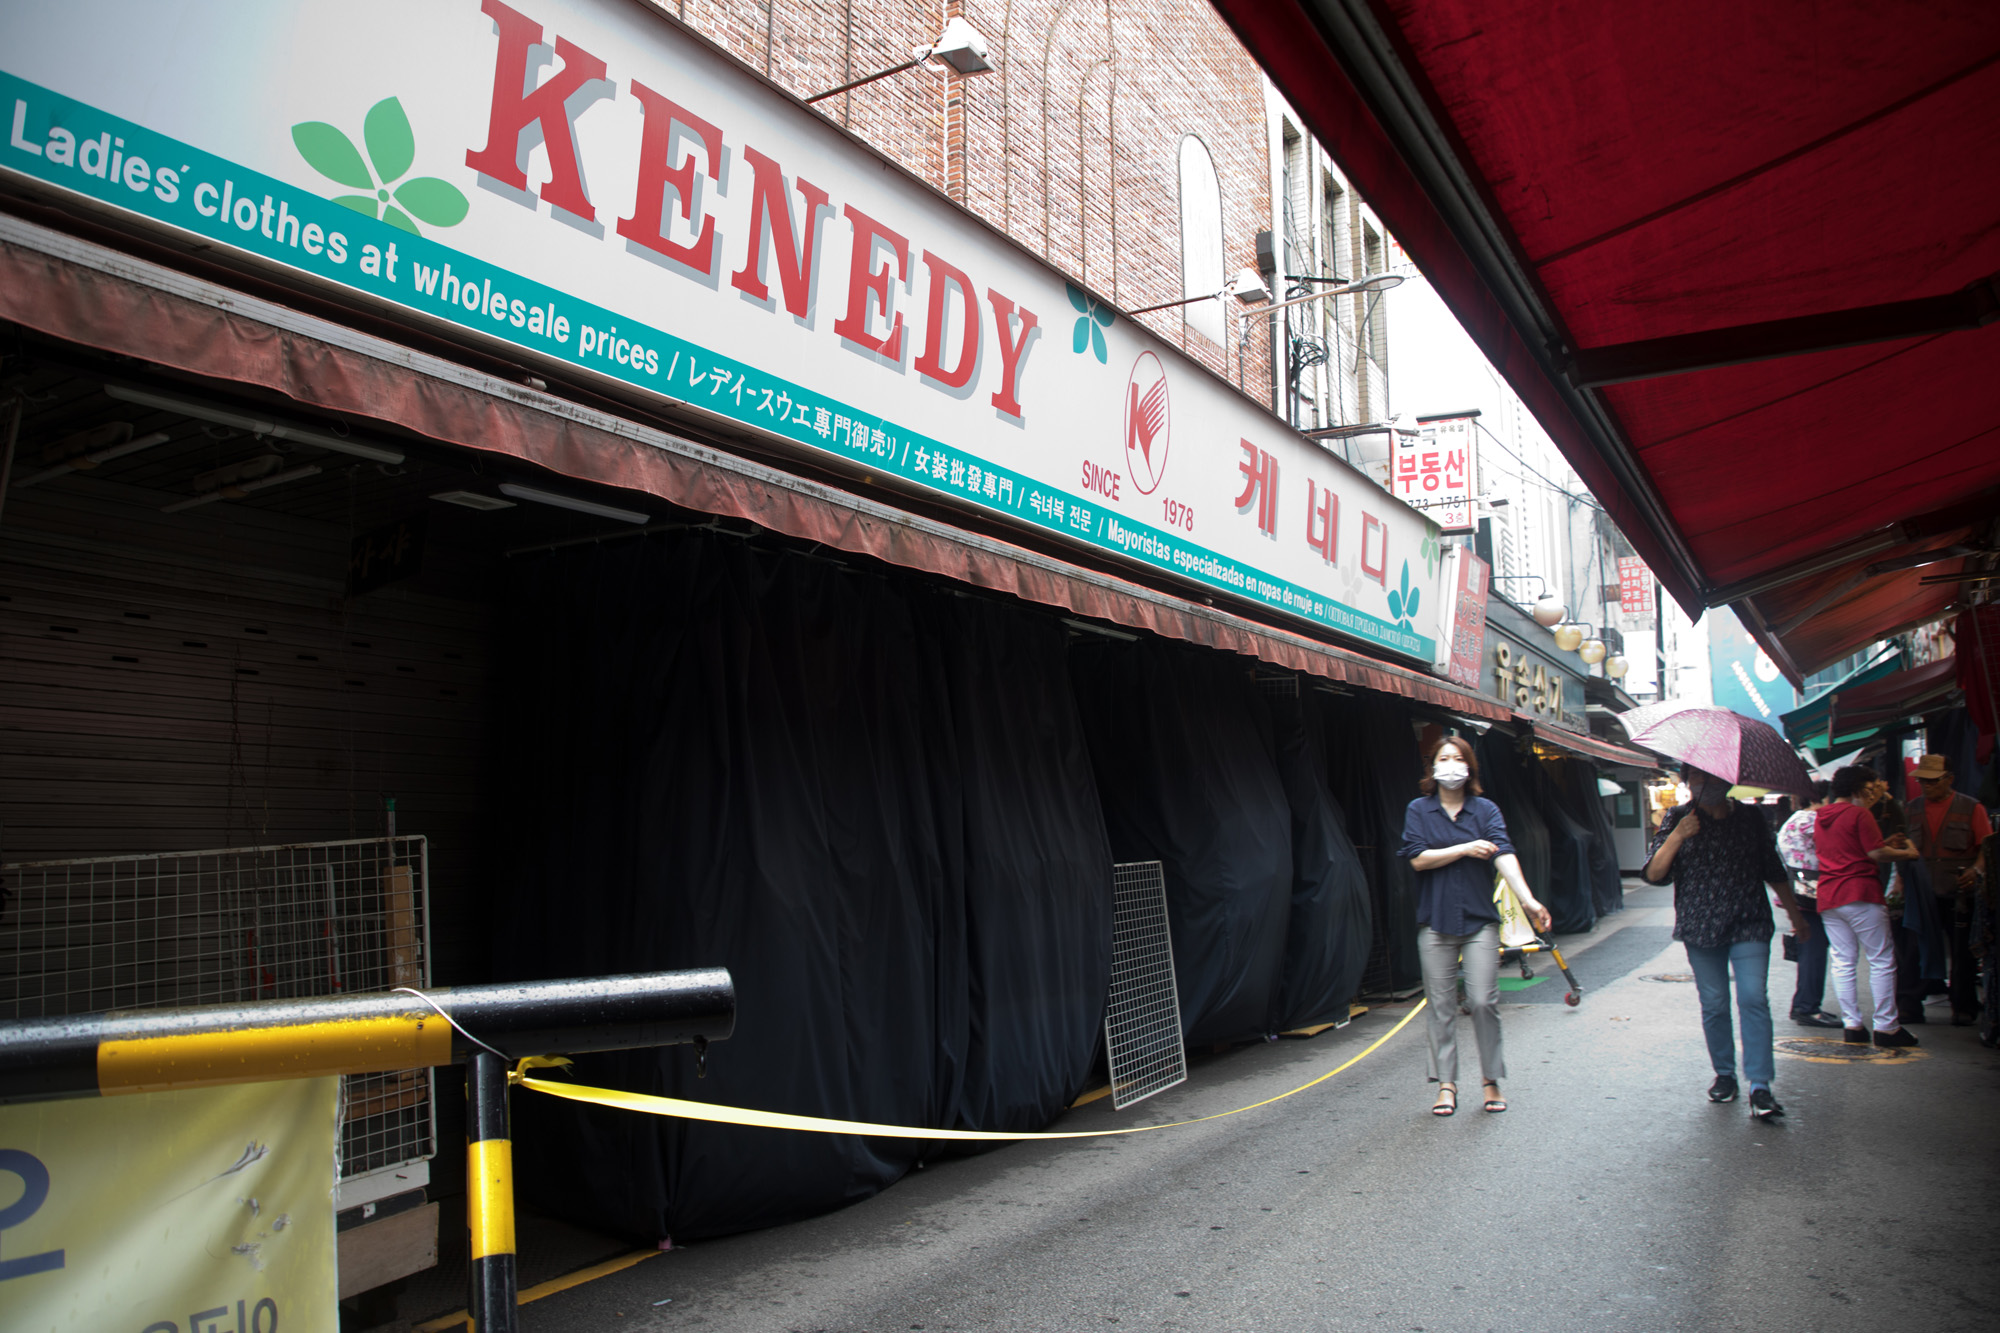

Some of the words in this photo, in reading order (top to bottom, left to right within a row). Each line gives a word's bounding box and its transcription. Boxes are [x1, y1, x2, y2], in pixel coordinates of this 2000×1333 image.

[465, 0, 1040, 424] KENEDY
[193, 180, 348, 265] clothes
[360, 241, 398, 283] at
[413, 261, 570, 344] wholesale
[578, 324, 659, 376] prices
[1081, 459, 1121, 502] SINCE
[1397, 448, 1465, 494] 부동산
[1029, 490, 1065, 524] 숙녀복
[1069, 507, 1092, 533] 전문
[1162, 497, 1194, 532] 1978
[1234, 438, 1389, 588] 케네디
[1107, 518, 1171, 562] Mayoristas
[1173, 547, 1245, 588] especializadas
[1245, 571, 1257, 593] en
[1258, 579, 1282, 605] ropas
[1282, 586, 1293, 606] de
[1314, 601, 1324, 617] es
